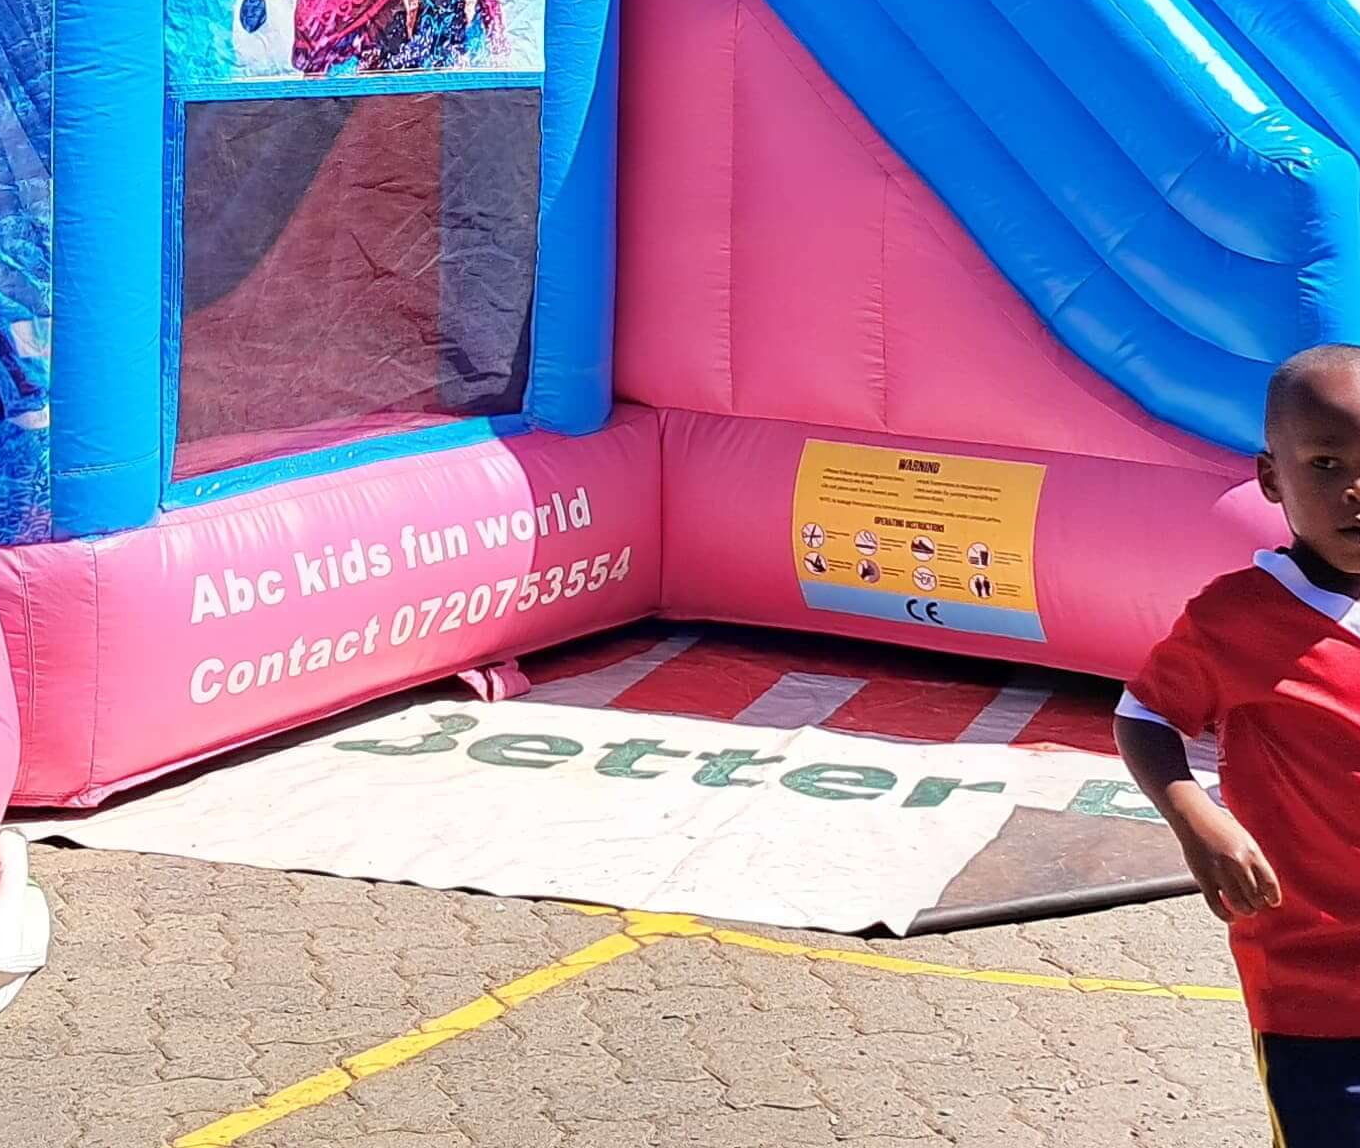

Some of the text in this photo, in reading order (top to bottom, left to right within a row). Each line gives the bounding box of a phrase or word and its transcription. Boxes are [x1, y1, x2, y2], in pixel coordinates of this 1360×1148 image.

[898, 458, 940, 474] WARNING
[190, 487, 592, 624] Abc kids fun world
[189, 546, 632, 705] Contact 0720753554
[906, 599, 944, 625] CE
